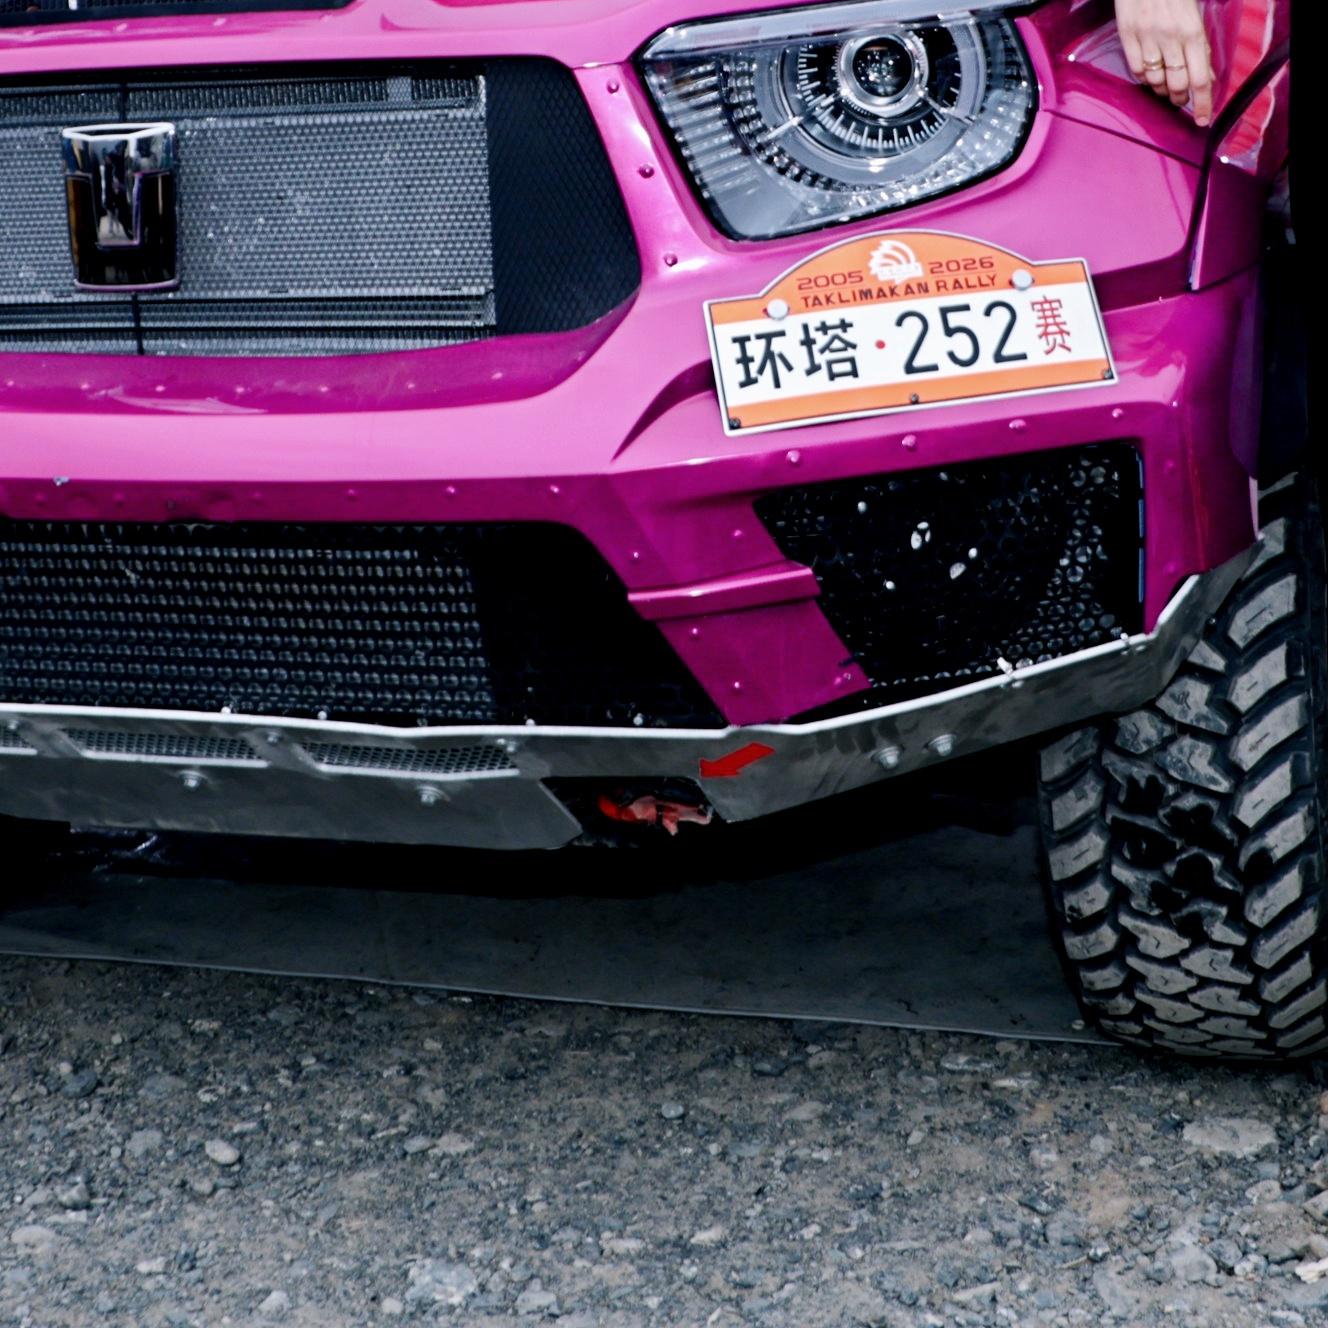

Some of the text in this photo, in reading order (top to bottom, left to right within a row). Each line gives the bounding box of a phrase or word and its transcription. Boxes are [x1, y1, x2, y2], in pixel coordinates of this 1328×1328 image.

[928, 256, 995, 275] 2026
[796, 270, 864, 291] 2005
[800, 282, 930, 309] TAKLIMAKAN
[935, 273, 998, 292] RALLY
